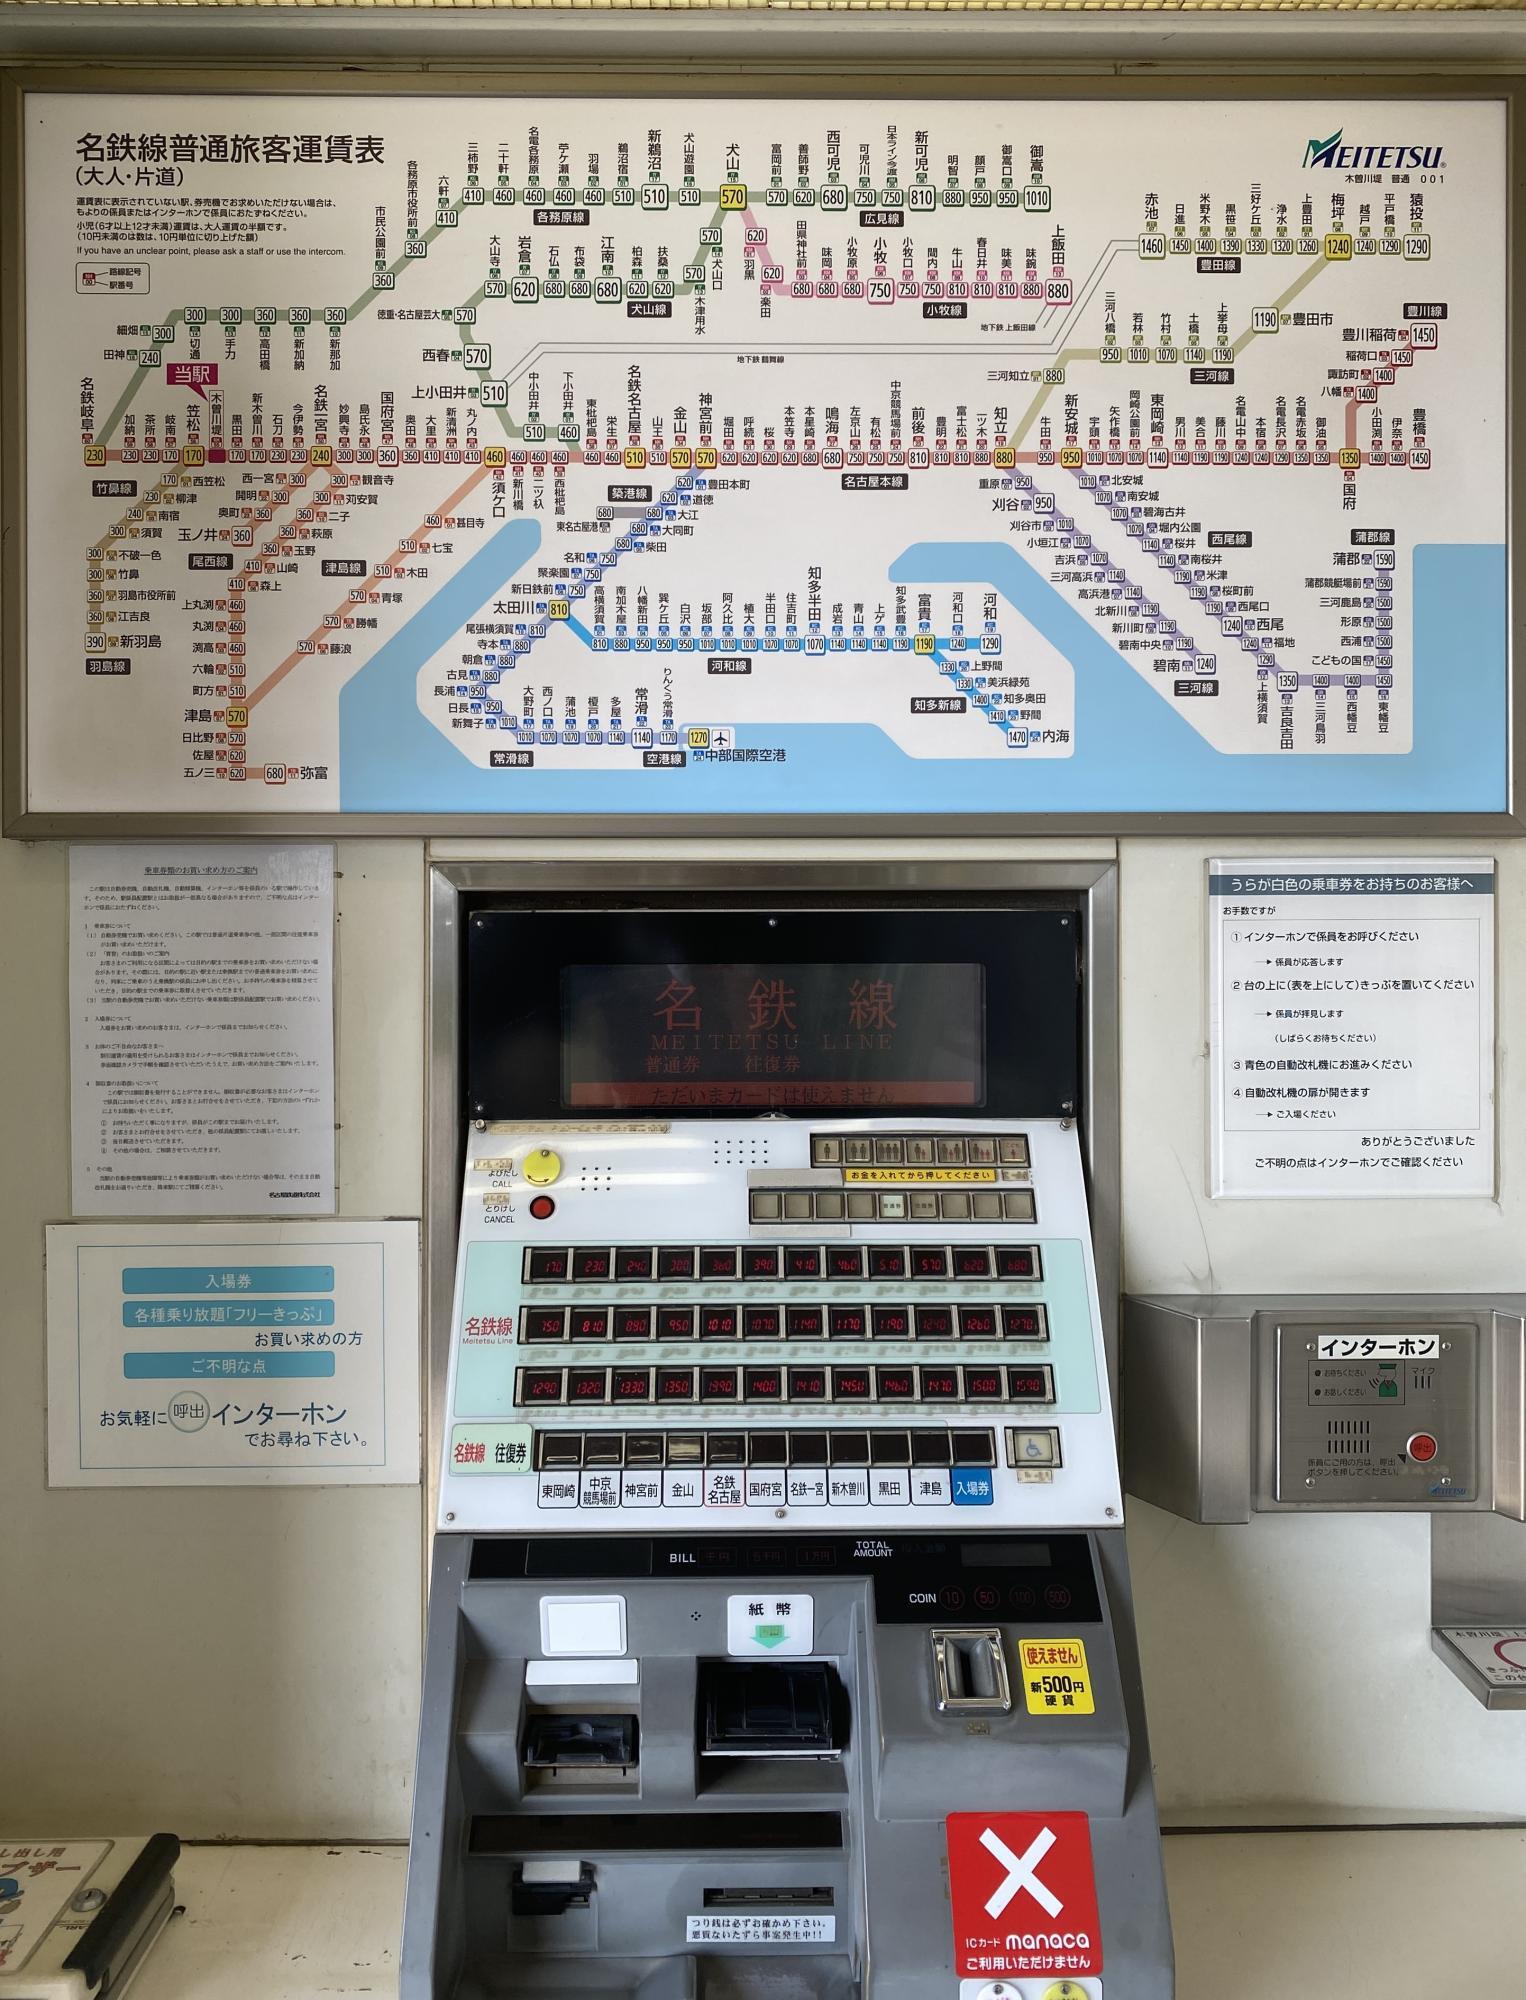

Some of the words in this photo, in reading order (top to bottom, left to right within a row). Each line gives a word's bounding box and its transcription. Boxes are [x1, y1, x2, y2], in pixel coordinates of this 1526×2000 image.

[76, 133, 385, 163] 名鉄線普通旅客運賃表
[648, 129, 662, 171] 新鵜沼
[915, 130, 929, 171] 新可児
[1303, 127, 1442, 170] MEITETSU
[726, 143, 740, 171] 犬山
[1345, 174, 1383, 185] 木曽川堤
[1391, 174, 1410, 185] 普通
[724, 188, 743, 205] 570
[1145, 193, 1159, 221] 赤池
[1410, 193, 1424, 221] 猿投
[537, 211, 587, 224] 各務原線
[864, 212, 900, 225] 広見線
[76, 246, 82, 254] If
[101, 246, 121, 254] have
[136, 246, 166, 254] unclear
[168, 246, 191, 256] point,
[193, 246, 220, 256] please
[223, 246, 237, 254] ask
[246, 246, 264, 254] staff
[293, 246, 306, 254] the
[308, 246, 346, 254] intercom.
[874, 237, 888, 264] 小牧
[1051, 224, 1066, 267] 上飯田
[1201, 260, 1237, 271] 豊田線
[109, 281, 134, 290] 駅番号
[870, 283, 891, 300] 750
[631, 303, 668, 316] 犬山線
[1407, 306, 1443, 318] 豊川線
[1254, 311, 1276, 328] 1190
[1292, 313, 1334, 327] 豊田市
[175, 366, 210, 383] 当駅
[411, 385, 467, 399] 上小田井
[81, 377, 95, 432] 名鉄岐阜
[627, 365, 642, 434] 名鉄名古屋
[314, 385, 328, 432] 名鉄一宮
[187, 405, 200, 432] 笠松
[1413, 408, 1427, 436] 豊橋
[86, 448, 103, 462] 230
[186, 448, 202, 462] 170
[96, 482, 133, 495] 竹鼻線
[844, 475, 905, 489] 名古屋本線
[178, 529, 218, 542] 玉ノ井
[1211, 533, 1248, 545] 西尾線
[1354, 531, 1391, 543] 蒲郡線
[193, 555, 228, 568] 尾西線
[1333, 552, 1360, 566] 蒲郡
[1376, 552, 1394, 567] 1590
[326, 562, 361, 575] 津島線
[808, 567, 822, 622] 知多半田
[493, 601, 534, 614] 太田川
[550, 602, 567, 617] 810
[711, 660, 748, 673] 河和線
[635, 688, 649, 715] 常滑
[914, 699, 962, 712] 知多新線
[1280, 706, 1294, 750] 吉良吉田
[493, 753, 530, 766] 常滑線
[646, 753, 683, 766] 空港線
[705, 749, 786, 763] 中部国際空港
[1231, 878, 1474, 891] うらが白色の乗車券をお持ちのお客様へ
[1223, 906, 1276, 915] お手数ですが
[1244, 931, 1419, 942] インターホンで係員をお呼びください
[1275, 958, 1344, 967] 係員が応答します
[1275, 1009, 1344, 1018] 係員が拝見します
[651, 1034, 799, 1050] MEITETSU
[822, 1034, 894, 1050] LINE
[1244, 1059, 1412, 1071] 青色の自動改札機にお進みください
[1245, 1087, 1370, 1098] 自動改札機の扉が開きます
[1276, 1110, 1336, 1119] ご入場ください
[1361, 1136, 1475, 1147] ありがとうございました
[1255, 1157, 1463, 1168] ご不明の点はインターホンでご確認ください
[851, 1171, 991, 1180] お金を入れてから押してください
[205, 1273, 252, 1289] 入場券
[466, 1316, 512, 1336] 名鉄線
[707, 1319, 732, 1332] 1010
[255, 1331, 363, 1347] お買い求めの方
[1322, 1338, 1436, 1357] インターホン
[192, 1358, 266, 1374] ご不明な点
[1411, 1367, 1436, 1375] マイク
[100, 1408, 167, 1427] お気軽に
[173, 1403, 204, 1419] 呼出
[212, 1402, 347, 1426] インターホン
[245, 1430, 368, 1448] でお尋ね下さい。
[454, 1443, 486, 1464] 名鉄線
[495, 1443, 526, 1464] 往復券
[589, 1477, 612, 1491] 中京
[713, 1475, 736, 1488] 名鉄
[878, 1481, 901, 1496] 黒田
[919, 1481, 942, 1496] 津島
[956, 1480, 989, 1496] 入場券
[542, 1484, 576, 1499] 東岡崎
[624, 1483, 658, 1498] 神宮前
[672, 1483, 694, 1497] 金山
[750, 1482, 783, 1497] 国府宮
[790, 1482, 824, 1497] 名鉄一宮
[831, 1482, 865, 1496] 新木曽川
[583, 1491, 617, 1506] 競馬場前
[708, 1489, 741, 1504] 名古屋
[855, 1541, 889, 1550] TOTAL
[669, 1552, 696, 1564] BILL
[853, 1549, 894, 1558] AMOUNT
[909, 1593, 937, 1604] COIN
[748, 1603, 791, 1616] 紙幣
[1026, 1647, 1079, 1666] 使えません
[1030, 1673, 1085, 1694] 新500円
[1045, 1694, 1075, 1707] 硬貨
[966, 1939, 1001, 1949] ICカード
[1006, 1934, 1090, 1950] manaca
[966, 1954, 1091, 1971] ご利用いただけません
